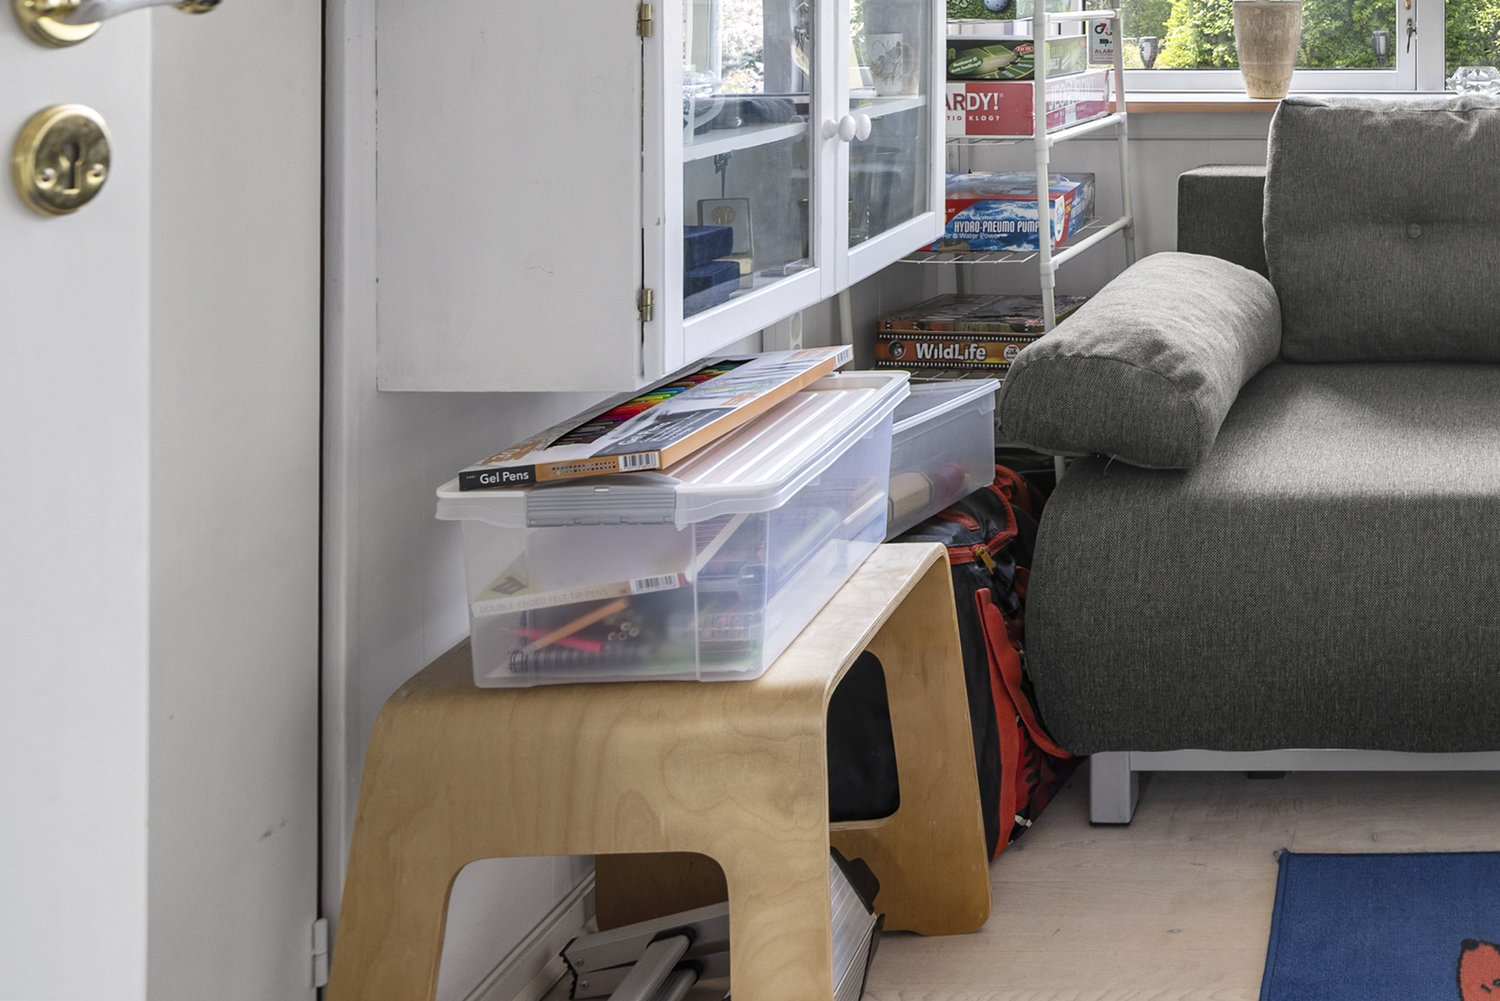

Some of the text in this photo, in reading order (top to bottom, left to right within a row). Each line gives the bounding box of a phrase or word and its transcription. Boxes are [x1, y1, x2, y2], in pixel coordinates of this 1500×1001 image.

[946, 92, 999, 111] ARDY!
[954, 220, 1014, 233] HYDRO-PNEUMO
[479, 471, 530, 484] Gel Pens
